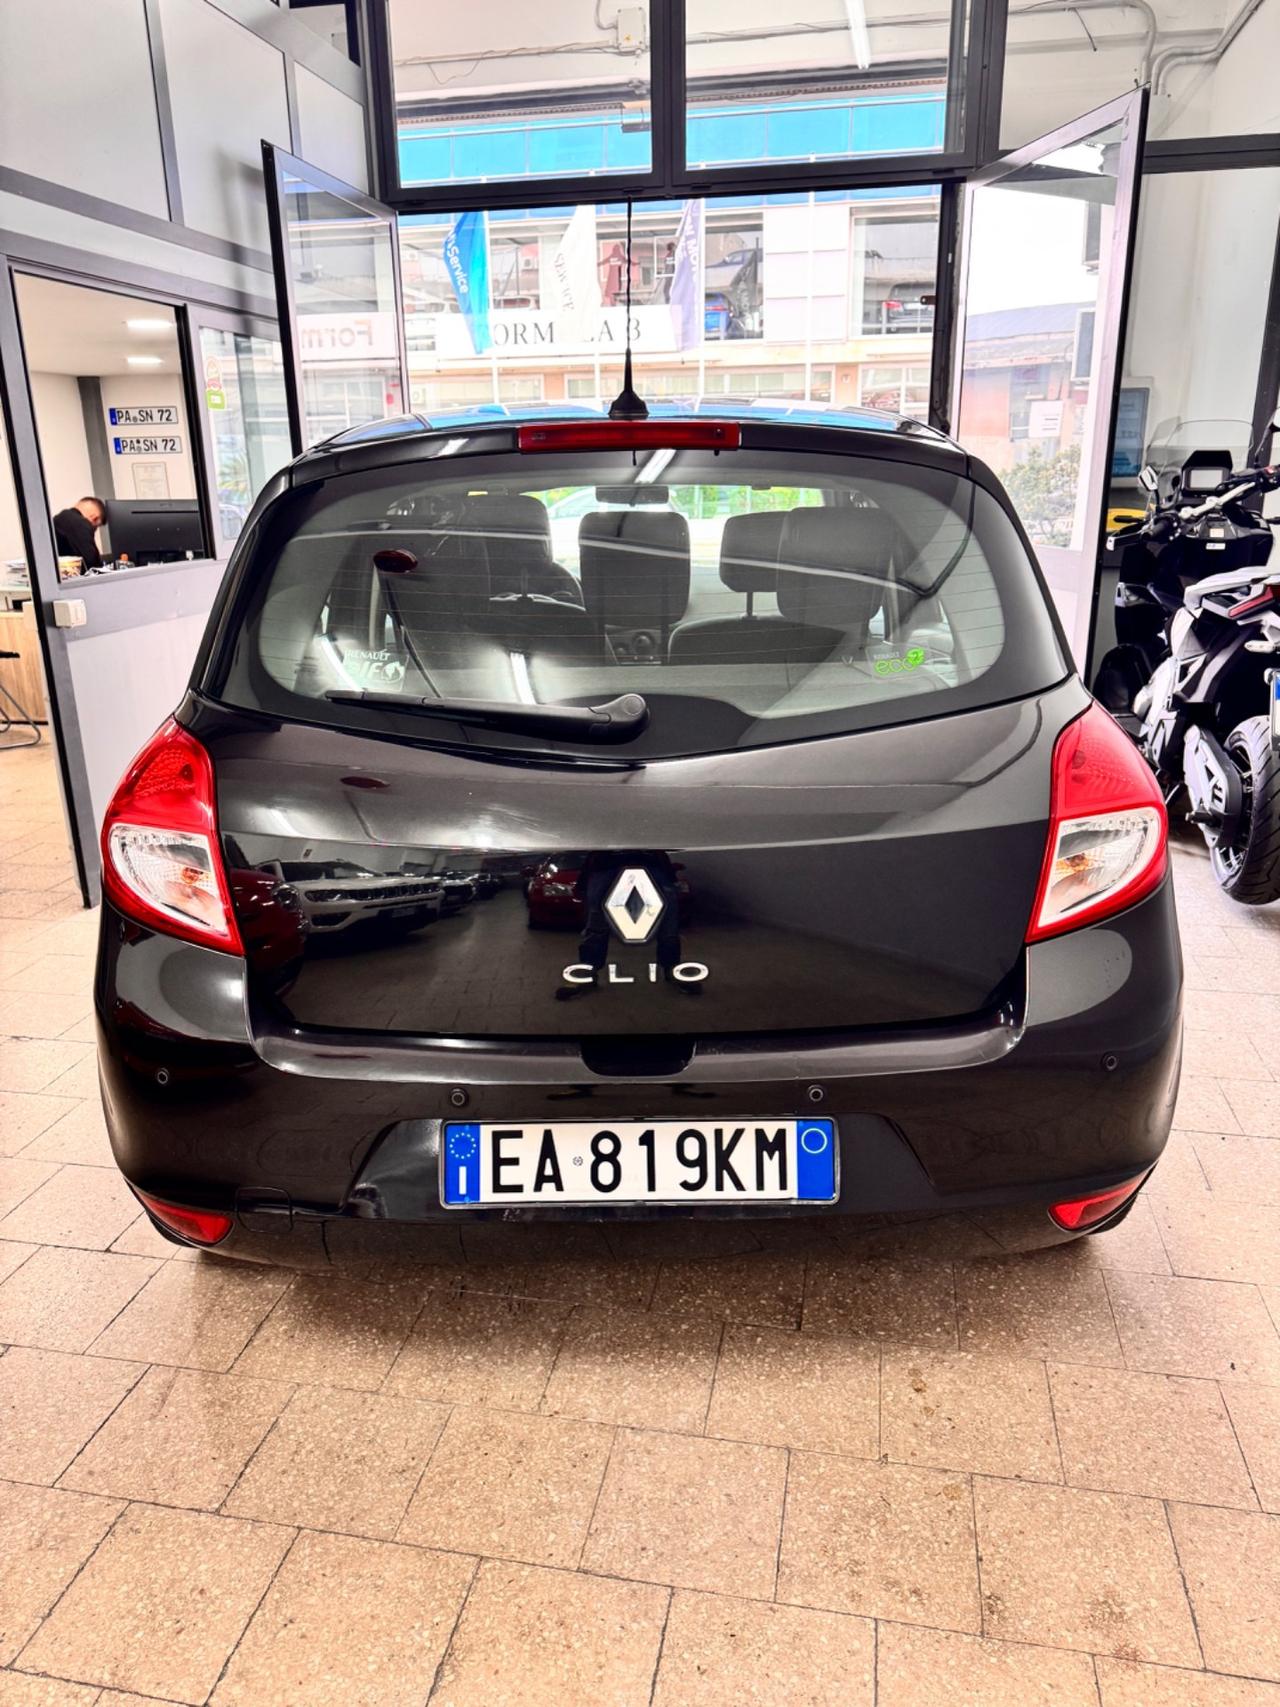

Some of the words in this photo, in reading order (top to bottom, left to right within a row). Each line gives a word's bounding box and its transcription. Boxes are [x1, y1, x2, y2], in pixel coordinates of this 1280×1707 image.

[117, 410, 132, 423] PA
[138, 409, 154, 422] SN
[157, 408, 173, 421] 72
[121, 439, 136, 452] PA
[143, 439, 158, 451] SN
[161, 438, 177, 451] 72
[562, 961, 710, 984] CLIO
